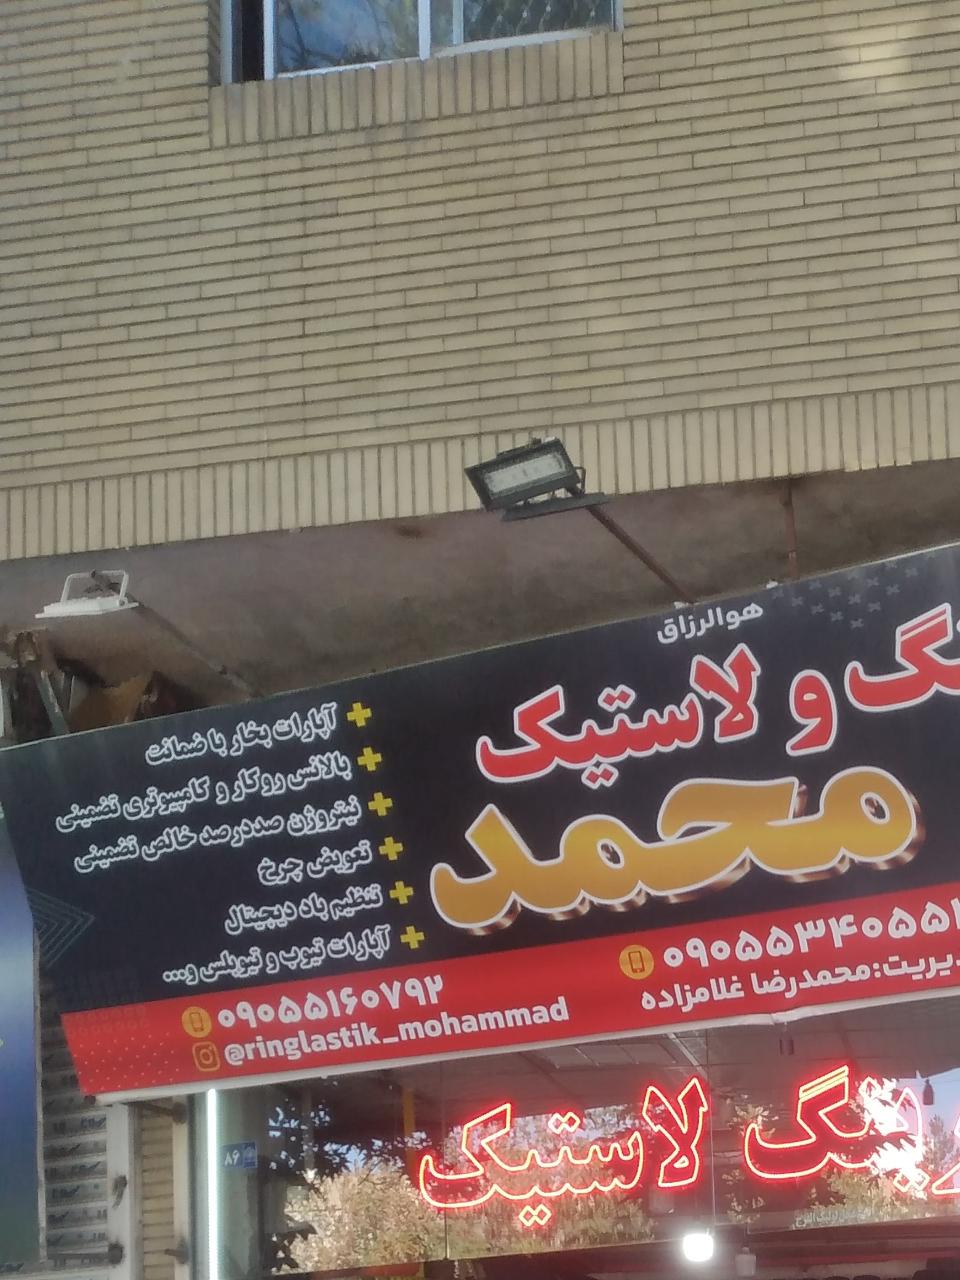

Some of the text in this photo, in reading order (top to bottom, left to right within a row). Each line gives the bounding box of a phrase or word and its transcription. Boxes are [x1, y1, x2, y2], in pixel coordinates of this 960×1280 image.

[272, 701, 338, 743] آپارات
[475, 642, 763, 788] لاستیک
[785, 668, 840, 757] و
[229, 720, 273, 756] بخار
[55, 750, 353, 833] بالانس روکار و کامپیوتری تضمینی
[287, 794, 363, 837] نیتروژن
[74, 834, 140, 873] تضمینی
[141, 825, 198, 861] خالص
[257, 839, 373, 886] تعویض چرخ
[428, 764, 922, 936] محمد
[224, 883, 384, 936] تنظیم باد دیجیتال
[265, 952, 280, 974] و
[326, 924, 391, 962] آپارات
[217, 974, 444, 1028] ۰۹۰۵۵۱۶۰۷۹۲
[641, 975, 745, 1012] غلامزاده
[224, 996, 570, 1066] @ringlastik_mohammad
[417, 1077, 709, 1229] لاستیک
